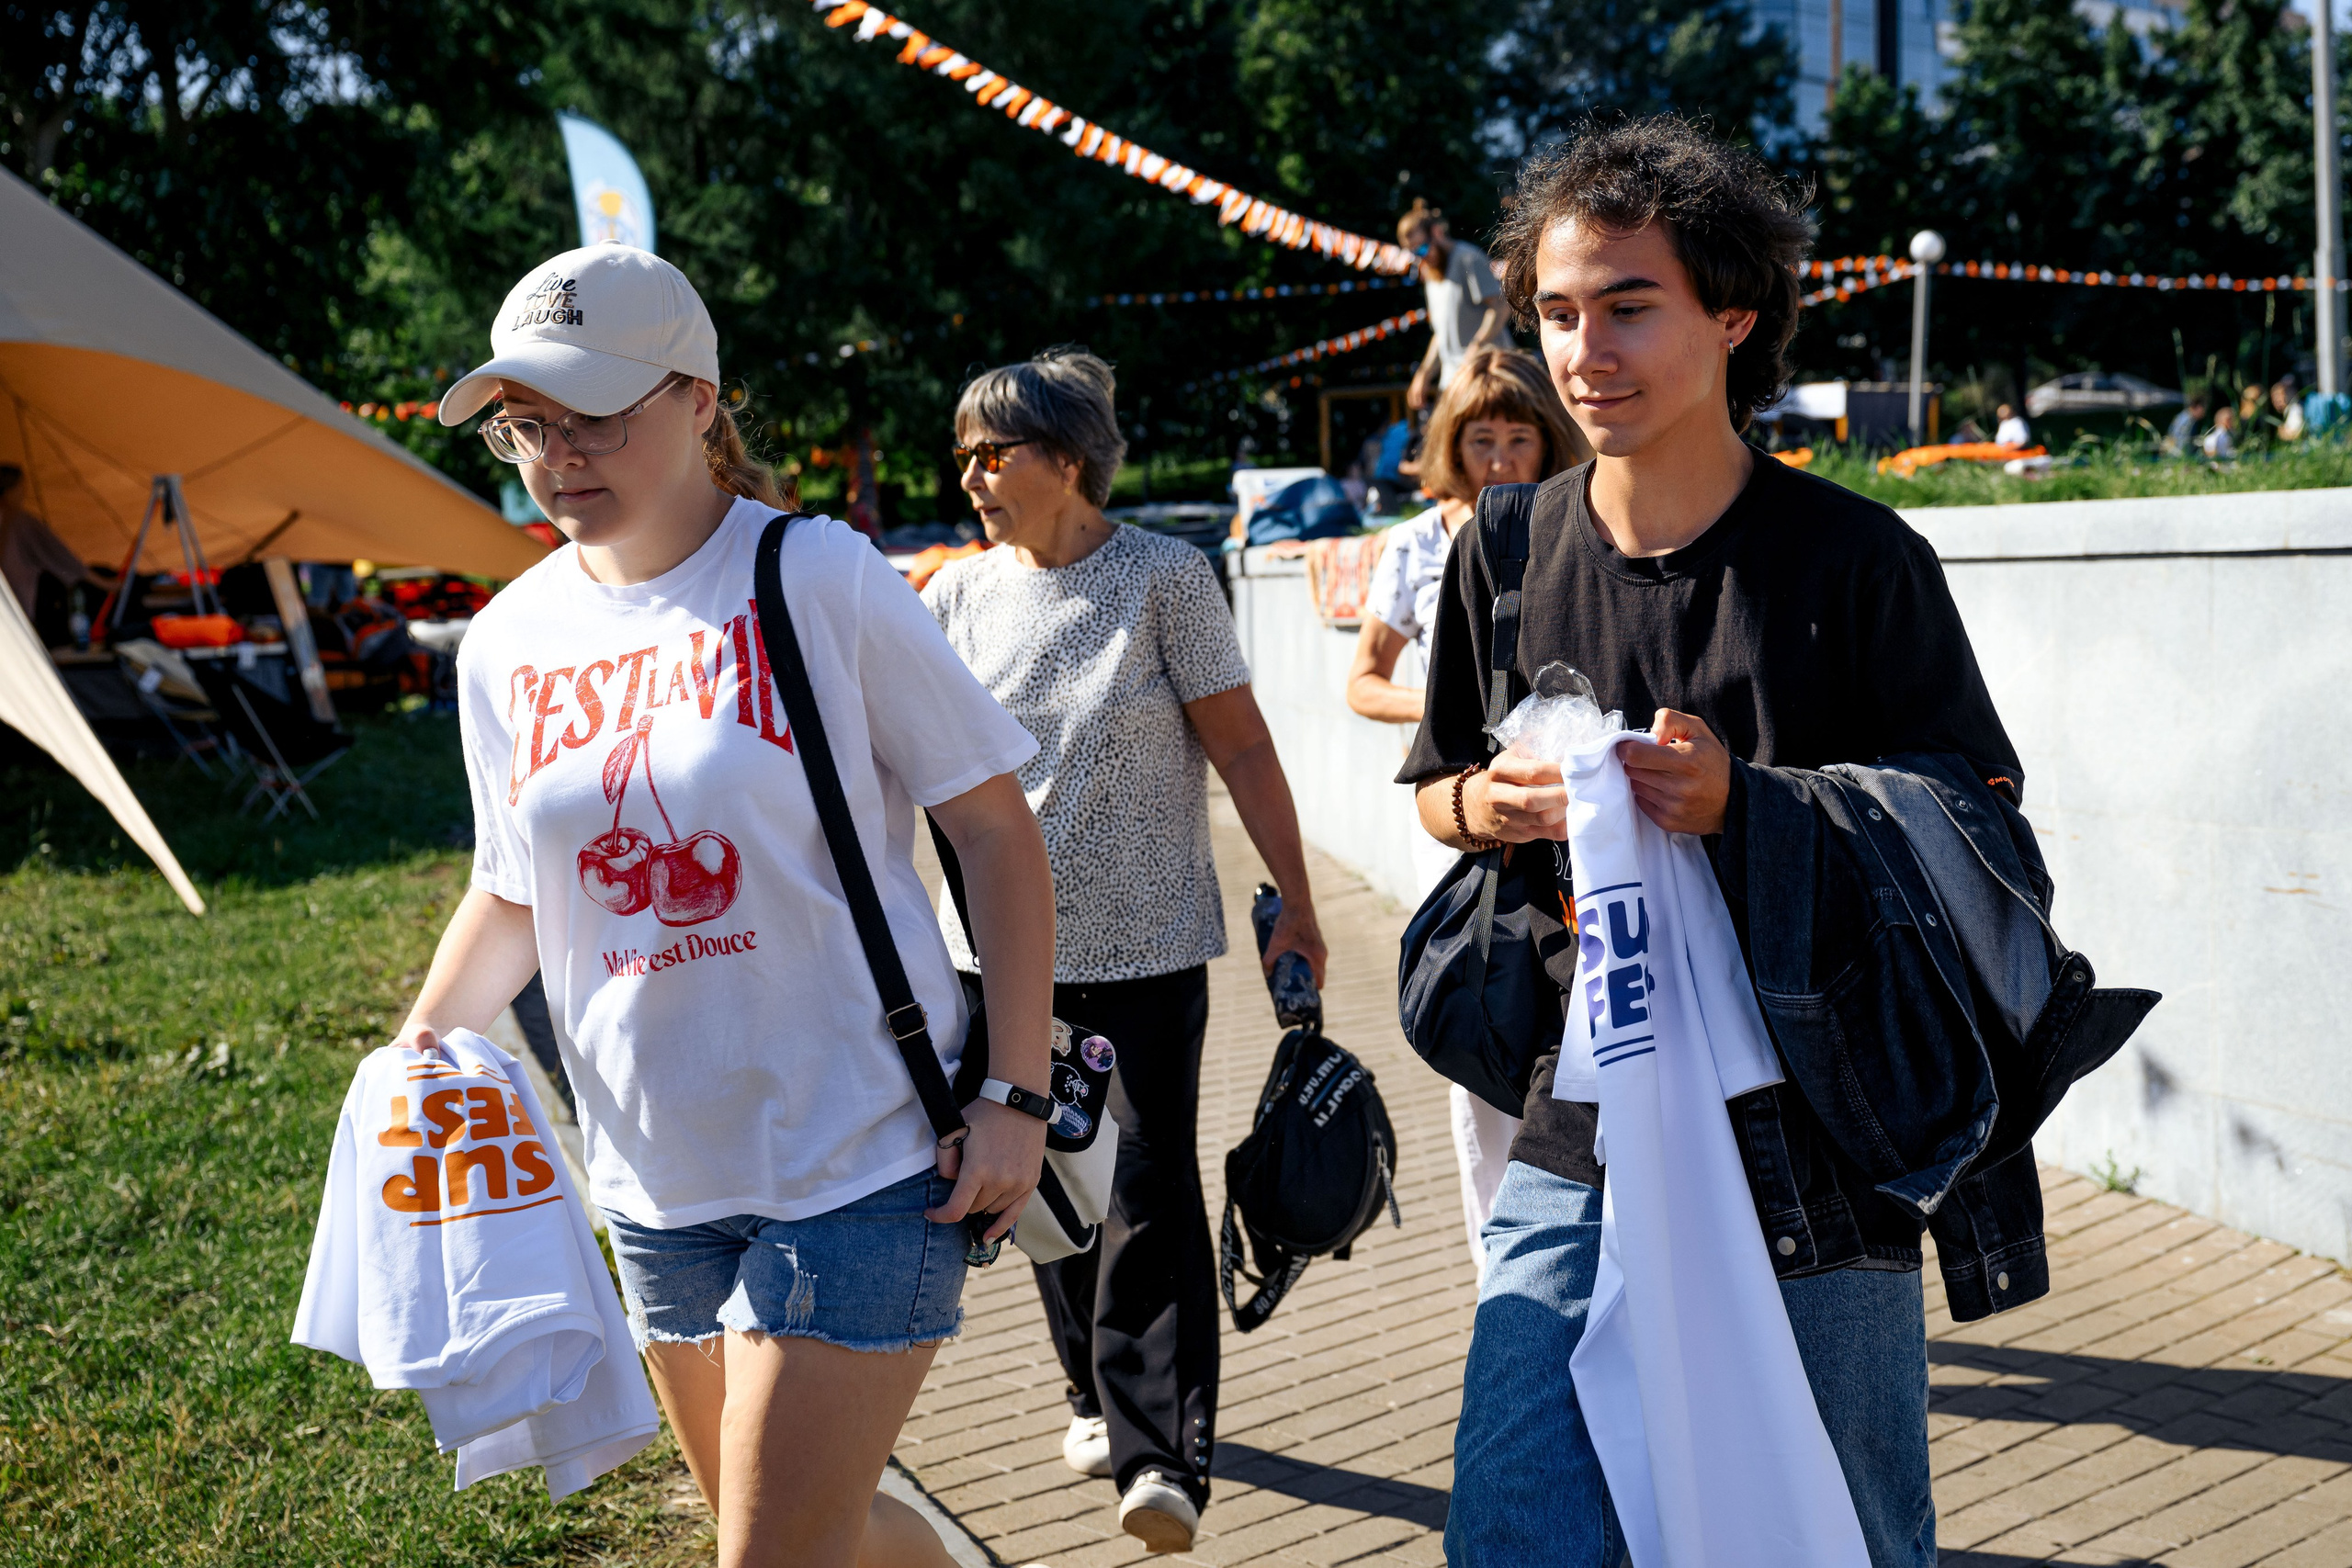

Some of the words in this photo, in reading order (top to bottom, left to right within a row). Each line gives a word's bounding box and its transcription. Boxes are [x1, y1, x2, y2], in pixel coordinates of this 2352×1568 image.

[512, 308, 582, 332] LAUGH
[645, 660, 690, 710] LA
[649, 942, 686, 972] est
[685, 931, 758, 962] Douce
[1577, 897, 1650, 975] SU
[381, 1140, 556, 1213] SUP
